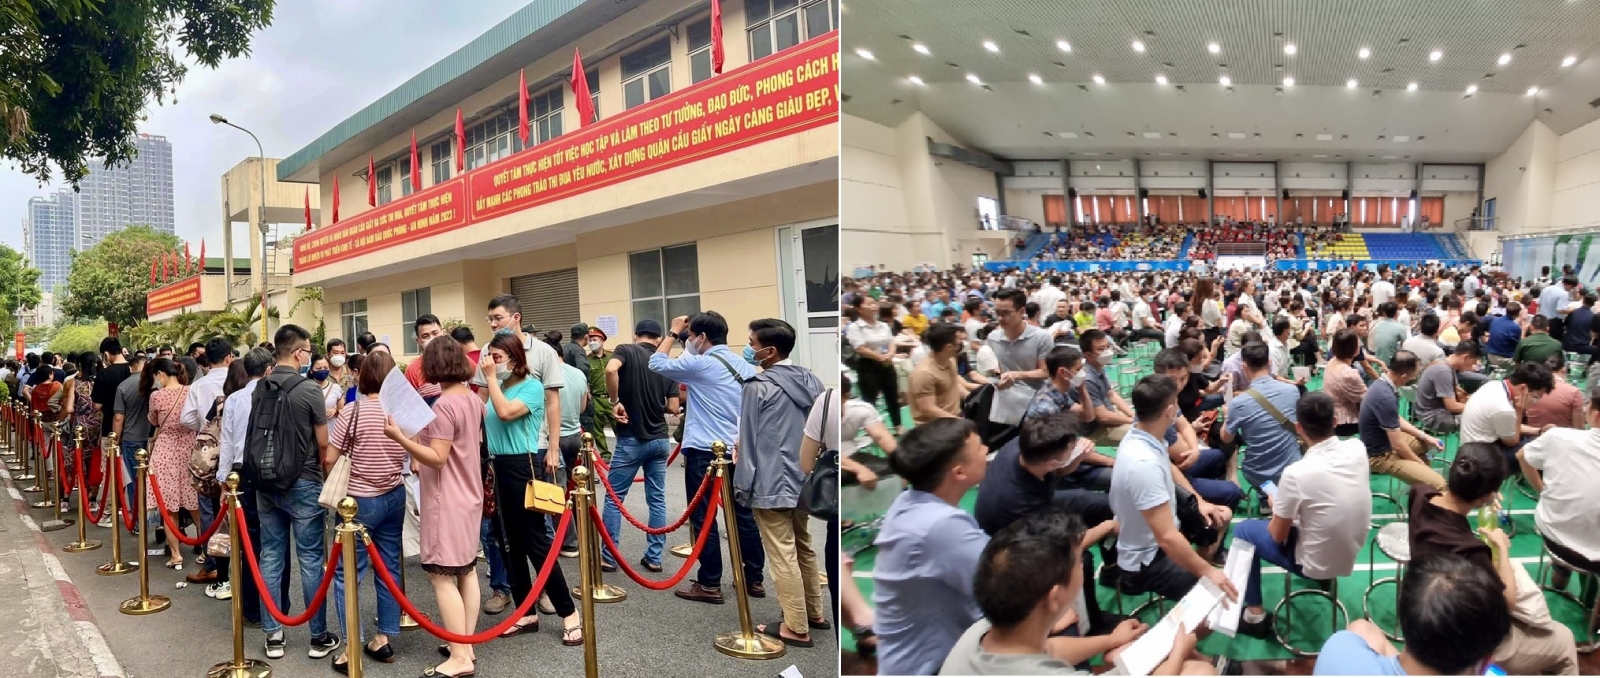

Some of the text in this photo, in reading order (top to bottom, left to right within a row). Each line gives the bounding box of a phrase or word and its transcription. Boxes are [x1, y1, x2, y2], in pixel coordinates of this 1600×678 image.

[486, 193, 501, 210] MẠNH
[502, 188, 512, 204] CÁC
[513, 184, 532, 200] PHONG
[532, 178, 548, 194] TRÀO
[548, 174, 558, 190] THI
[559, 170, 572, 186] ĐUA
[572, 165, 585, 182] YÊU
[586, 158, 607, 178] NƯỚC,
[608, 152, 623, 171] XÂY
[624, 148, 646, 168] DỰNG
[647, 138, 670, 160] QUẬN
[692, 120, 712, 146] GIẤY
[714, 115, 741, 138] NGÀY
[744, 106, 773, 129] CÀNG
[776, 96, 803, 120] GIÀU
[806, 87, 832, 111] ĐẸP,
[494, 168, 510, 187] QUYẾT
[510, 166, 521, 181] TÂM
[523, 161, 537, 177] THỰC
[538, 154, 552, 172] HIỆN
[553, 148, 564, 166] TỐT
[565, 145, 579, 163] VIỆC
[581, 140, 594, 158] HỌC
[596, 134, 609, 153] TẬP
[610, 129, 620, 146] VÀ
[622, 125, 638, 143] LÀM
[640, 117, 660, 137] THEO
[661, 110, 672, 129] TƯ
[674, 101, 706, 126] TƯỞNG,
[708, 93, 727, 115] ĐẠO
[730, 84, 753, 106] ĐỨC,
[756, 69, 793, 97] PHONG
[796, 56, 828, 83] CÁCH
